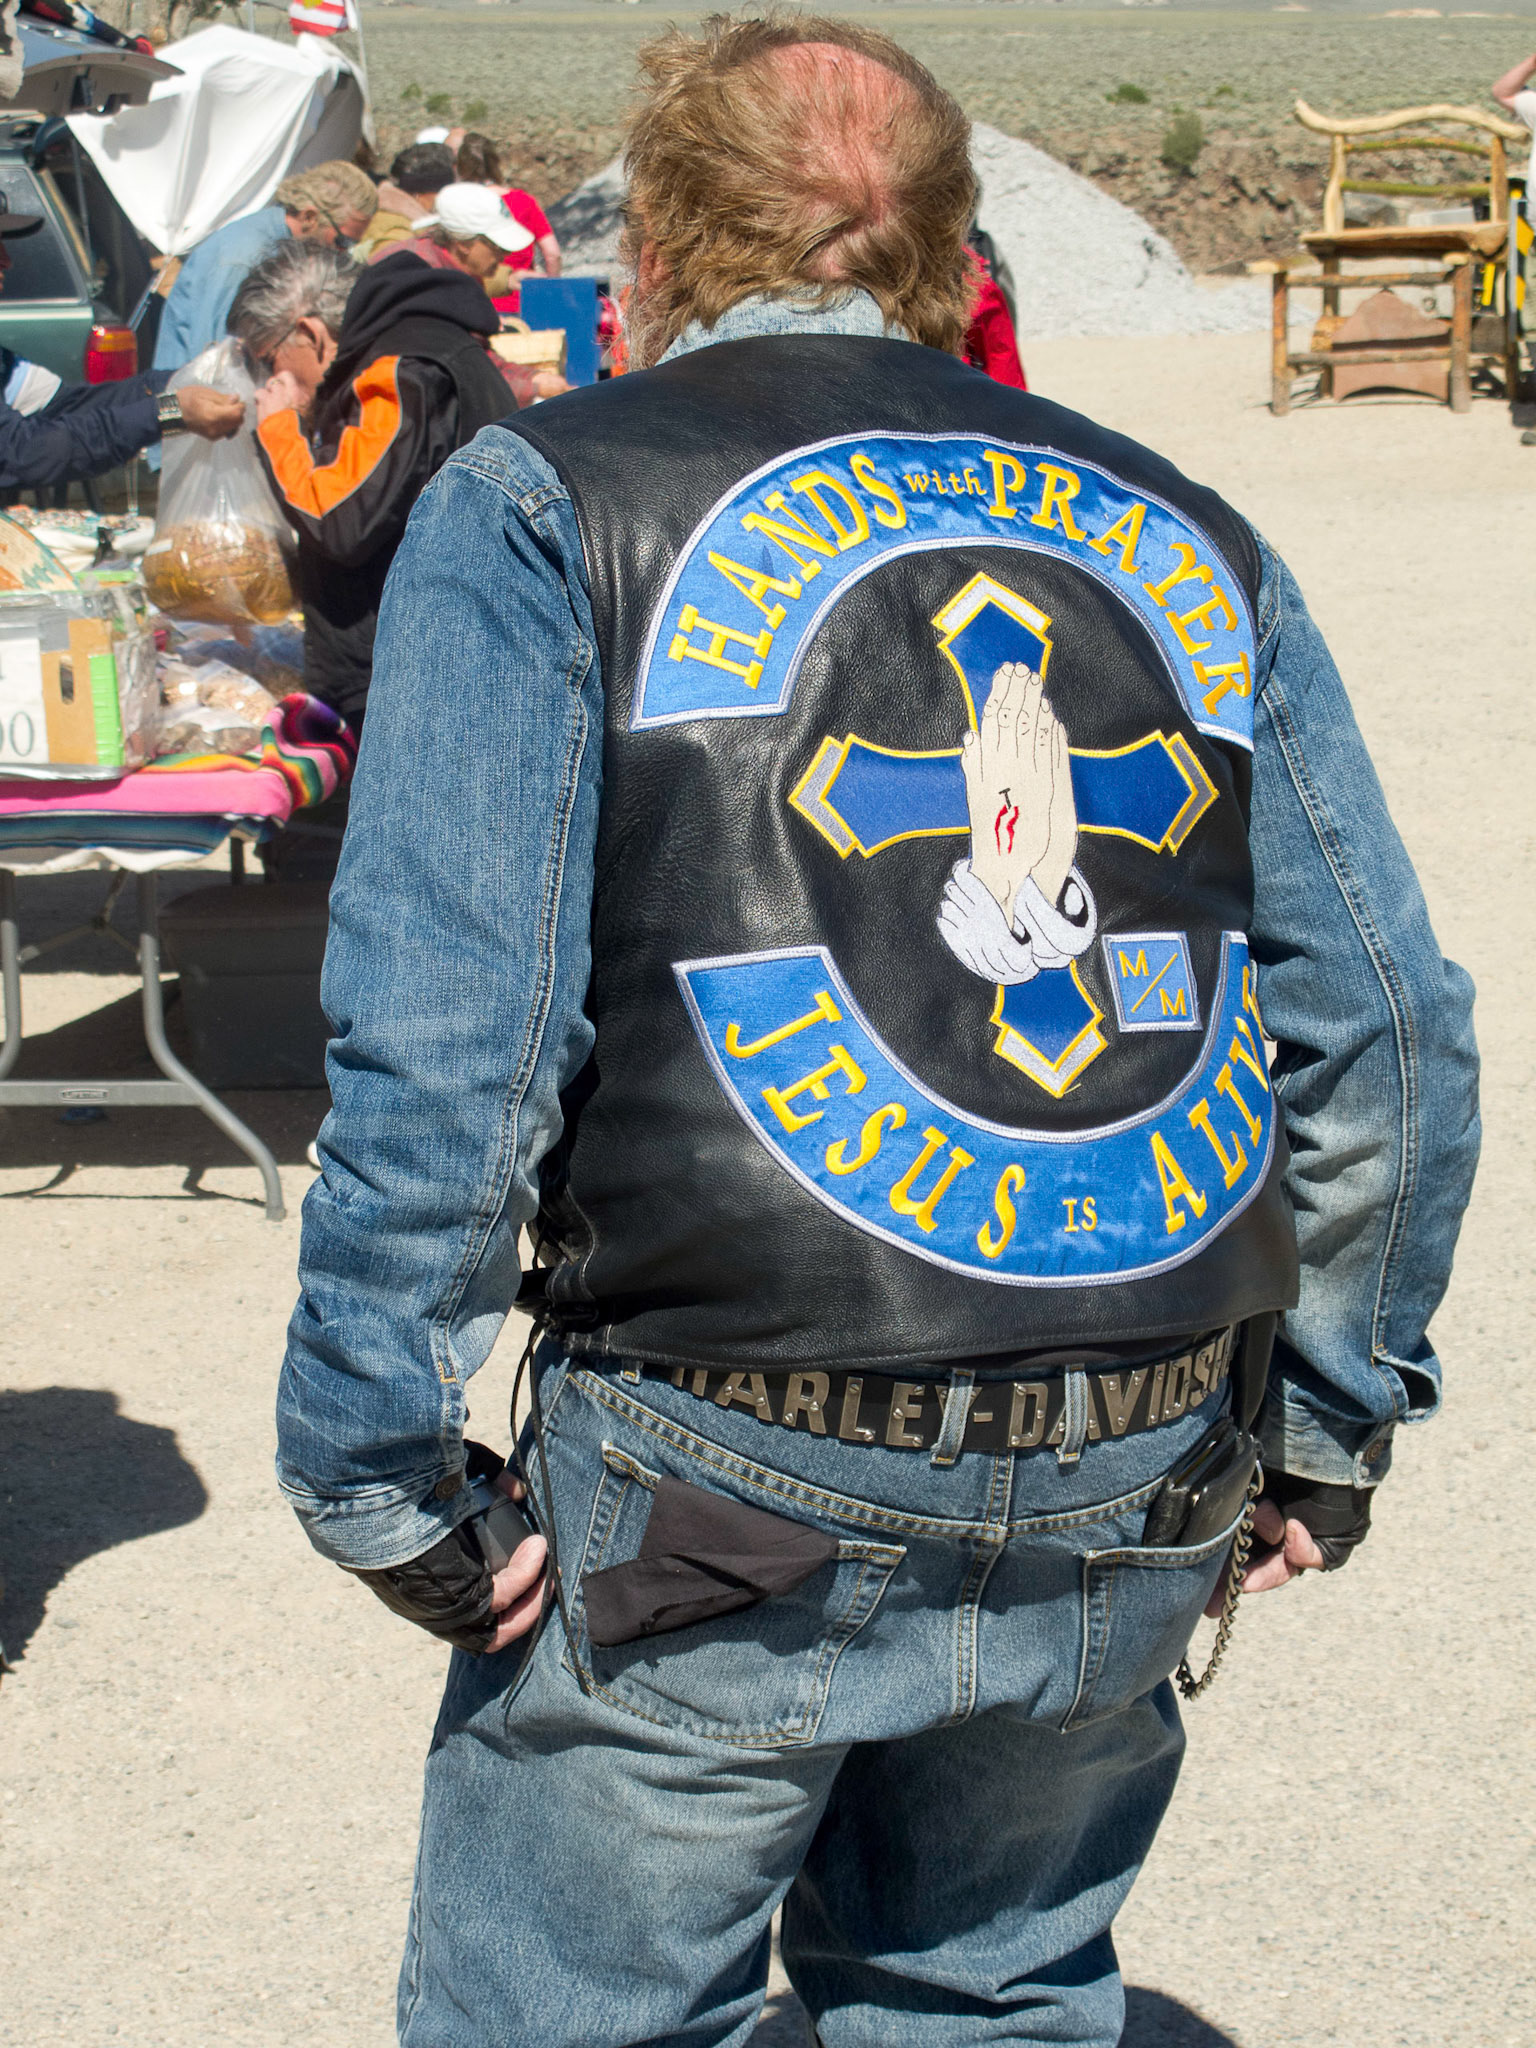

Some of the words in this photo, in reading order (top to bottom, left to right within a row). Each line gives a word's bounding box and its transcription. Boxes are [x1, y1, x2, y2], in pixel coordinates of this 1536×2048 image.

[668, 454, 907, 690] HANDS
[903, 468, 987, 496] with
[984, 449, 1253, 717] PRAYER
[0, 711, 34, 757] 0
[725, 991, 1027, 1260] JESUS
[1063, 1198, 1098, 1233] IS
